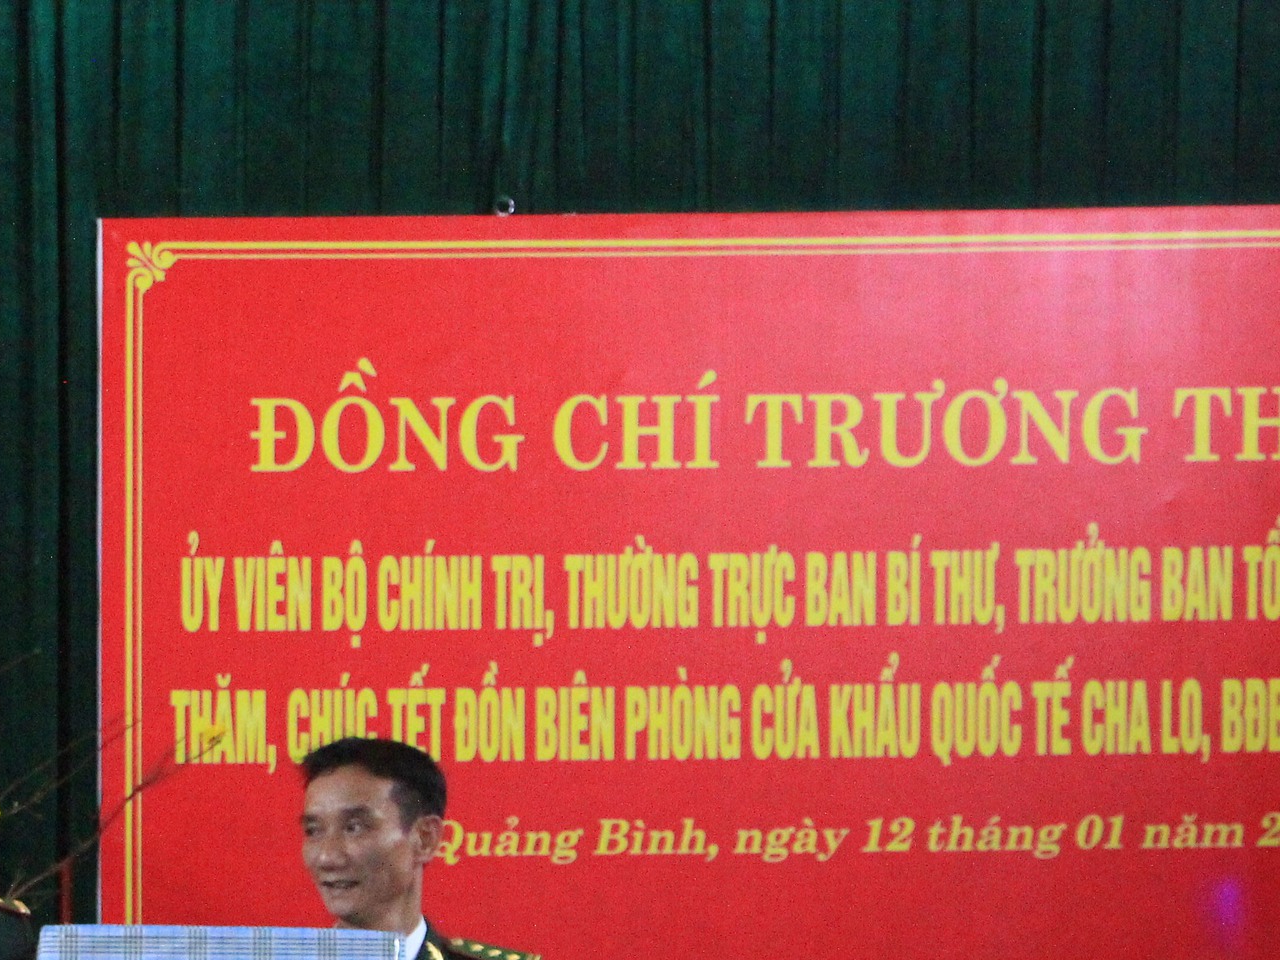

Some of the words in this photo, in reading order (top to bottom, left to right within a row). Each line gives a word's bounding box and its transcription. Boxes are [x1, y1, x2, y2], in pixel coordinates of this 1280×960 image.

[250, 357, 525, 472] ĐỒNG
[552, 370, 721, 471] CHÍ
[746, 377, 1149, 469] TRƯƠNG
[181, 530, 225, 633] ỦY
[234, 536, 312, 631] VIÊN
[322, 540, 368, 648] BỘ
[376, 540, 483, 632] CHÍNH
[492, 553, 555, 648] TRỊ,
[564, 535, 699, 630] THƯỜNG
[709, 543, 795, 643] TRỰC
[806, 549, 877, 628] BAN
[886, 534, 922, 627] BÍ
[931, 541, 1005, 634] THƯ,
[1016, 522, 1151, 625] TRƯỞNG
[1161, 546, 1233, 622] BAN
[170, 673, 277, 775] THĂM,
[287, 672, 378, 765] CHÚC
[386, 663, 446, 763] TẾT
[454, 660, 526, 763] ĐỒN
[535, 669, 615, 762] BIÊN
[625, 665, 742, 761] PHÒNG
[751, 658, 821, 760] CỬA
[829, 651, 921, 759] KHẨU
[931, 654, 1022, 766] QUỐC
[1032, 655, 1072, 757] TẾ
[1082, 679, 1152, 756] CHA
[1161, 678, 1211, 763] LO,
[435, 815, 585, 866] Quảng
[594, 816, 720, 864] Bình,
[734, 816, 850, 861] ngày
[861, 815, 916, 853] 12
[928, 812, 1068, 859] tháng
[1076, 813, 1125, 850] 01
[1142, 813, 1245, 849] năm
